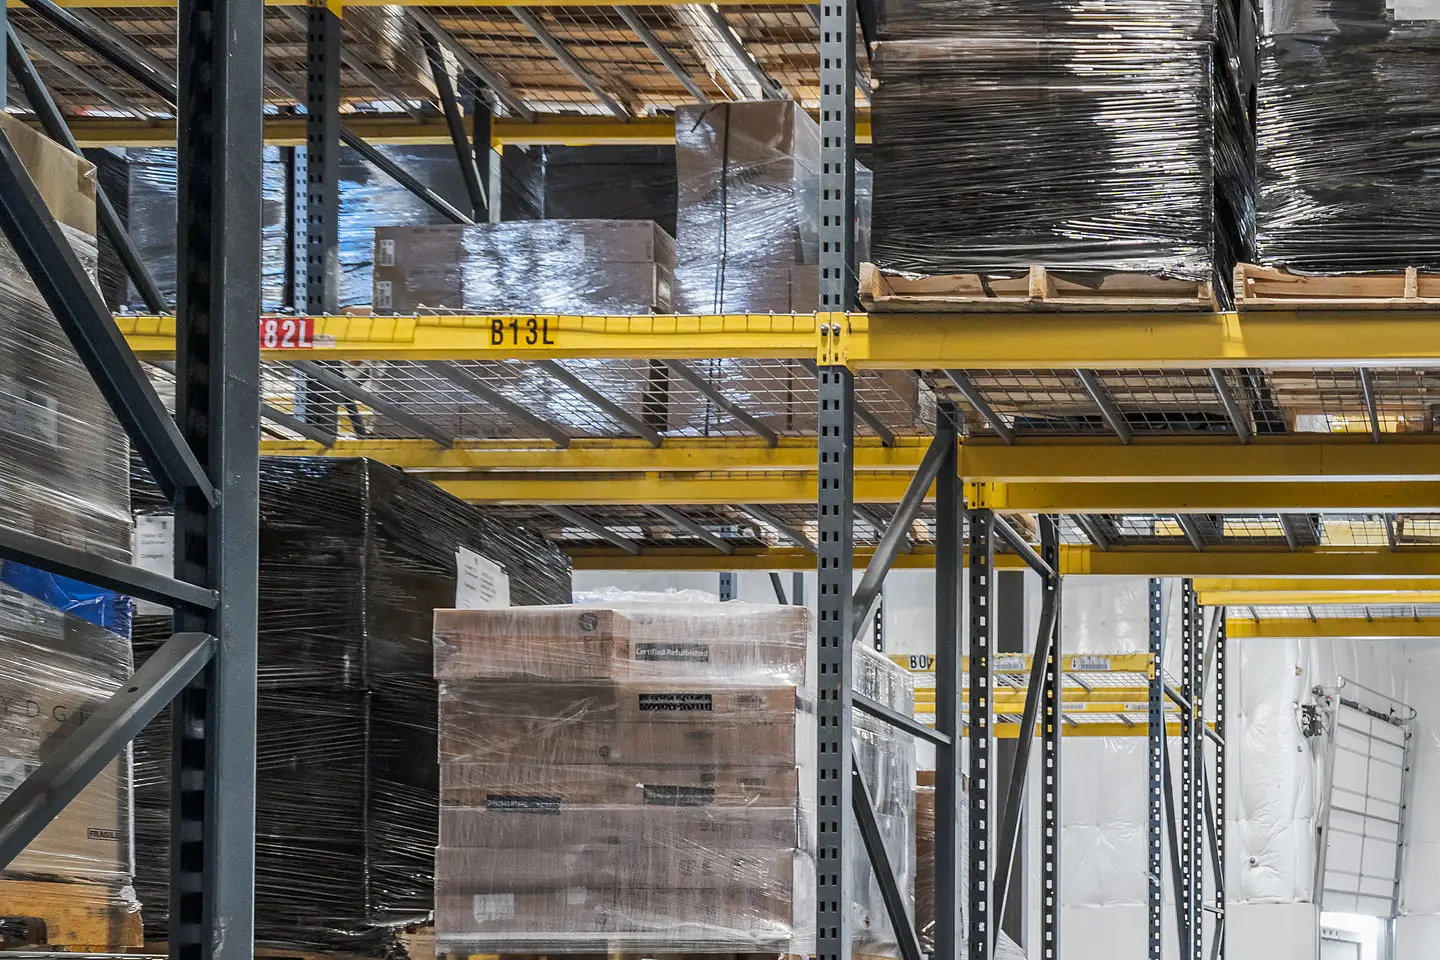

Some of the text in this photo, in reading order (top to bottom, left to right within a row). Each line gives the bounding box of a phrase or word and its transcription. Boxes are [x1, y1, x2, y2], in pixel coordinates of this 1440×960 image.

[259, 320, 313, 348] 82L
[491, 318, 554, 345] B13L
[635, 648, 709, 657] Certified Refurbished
